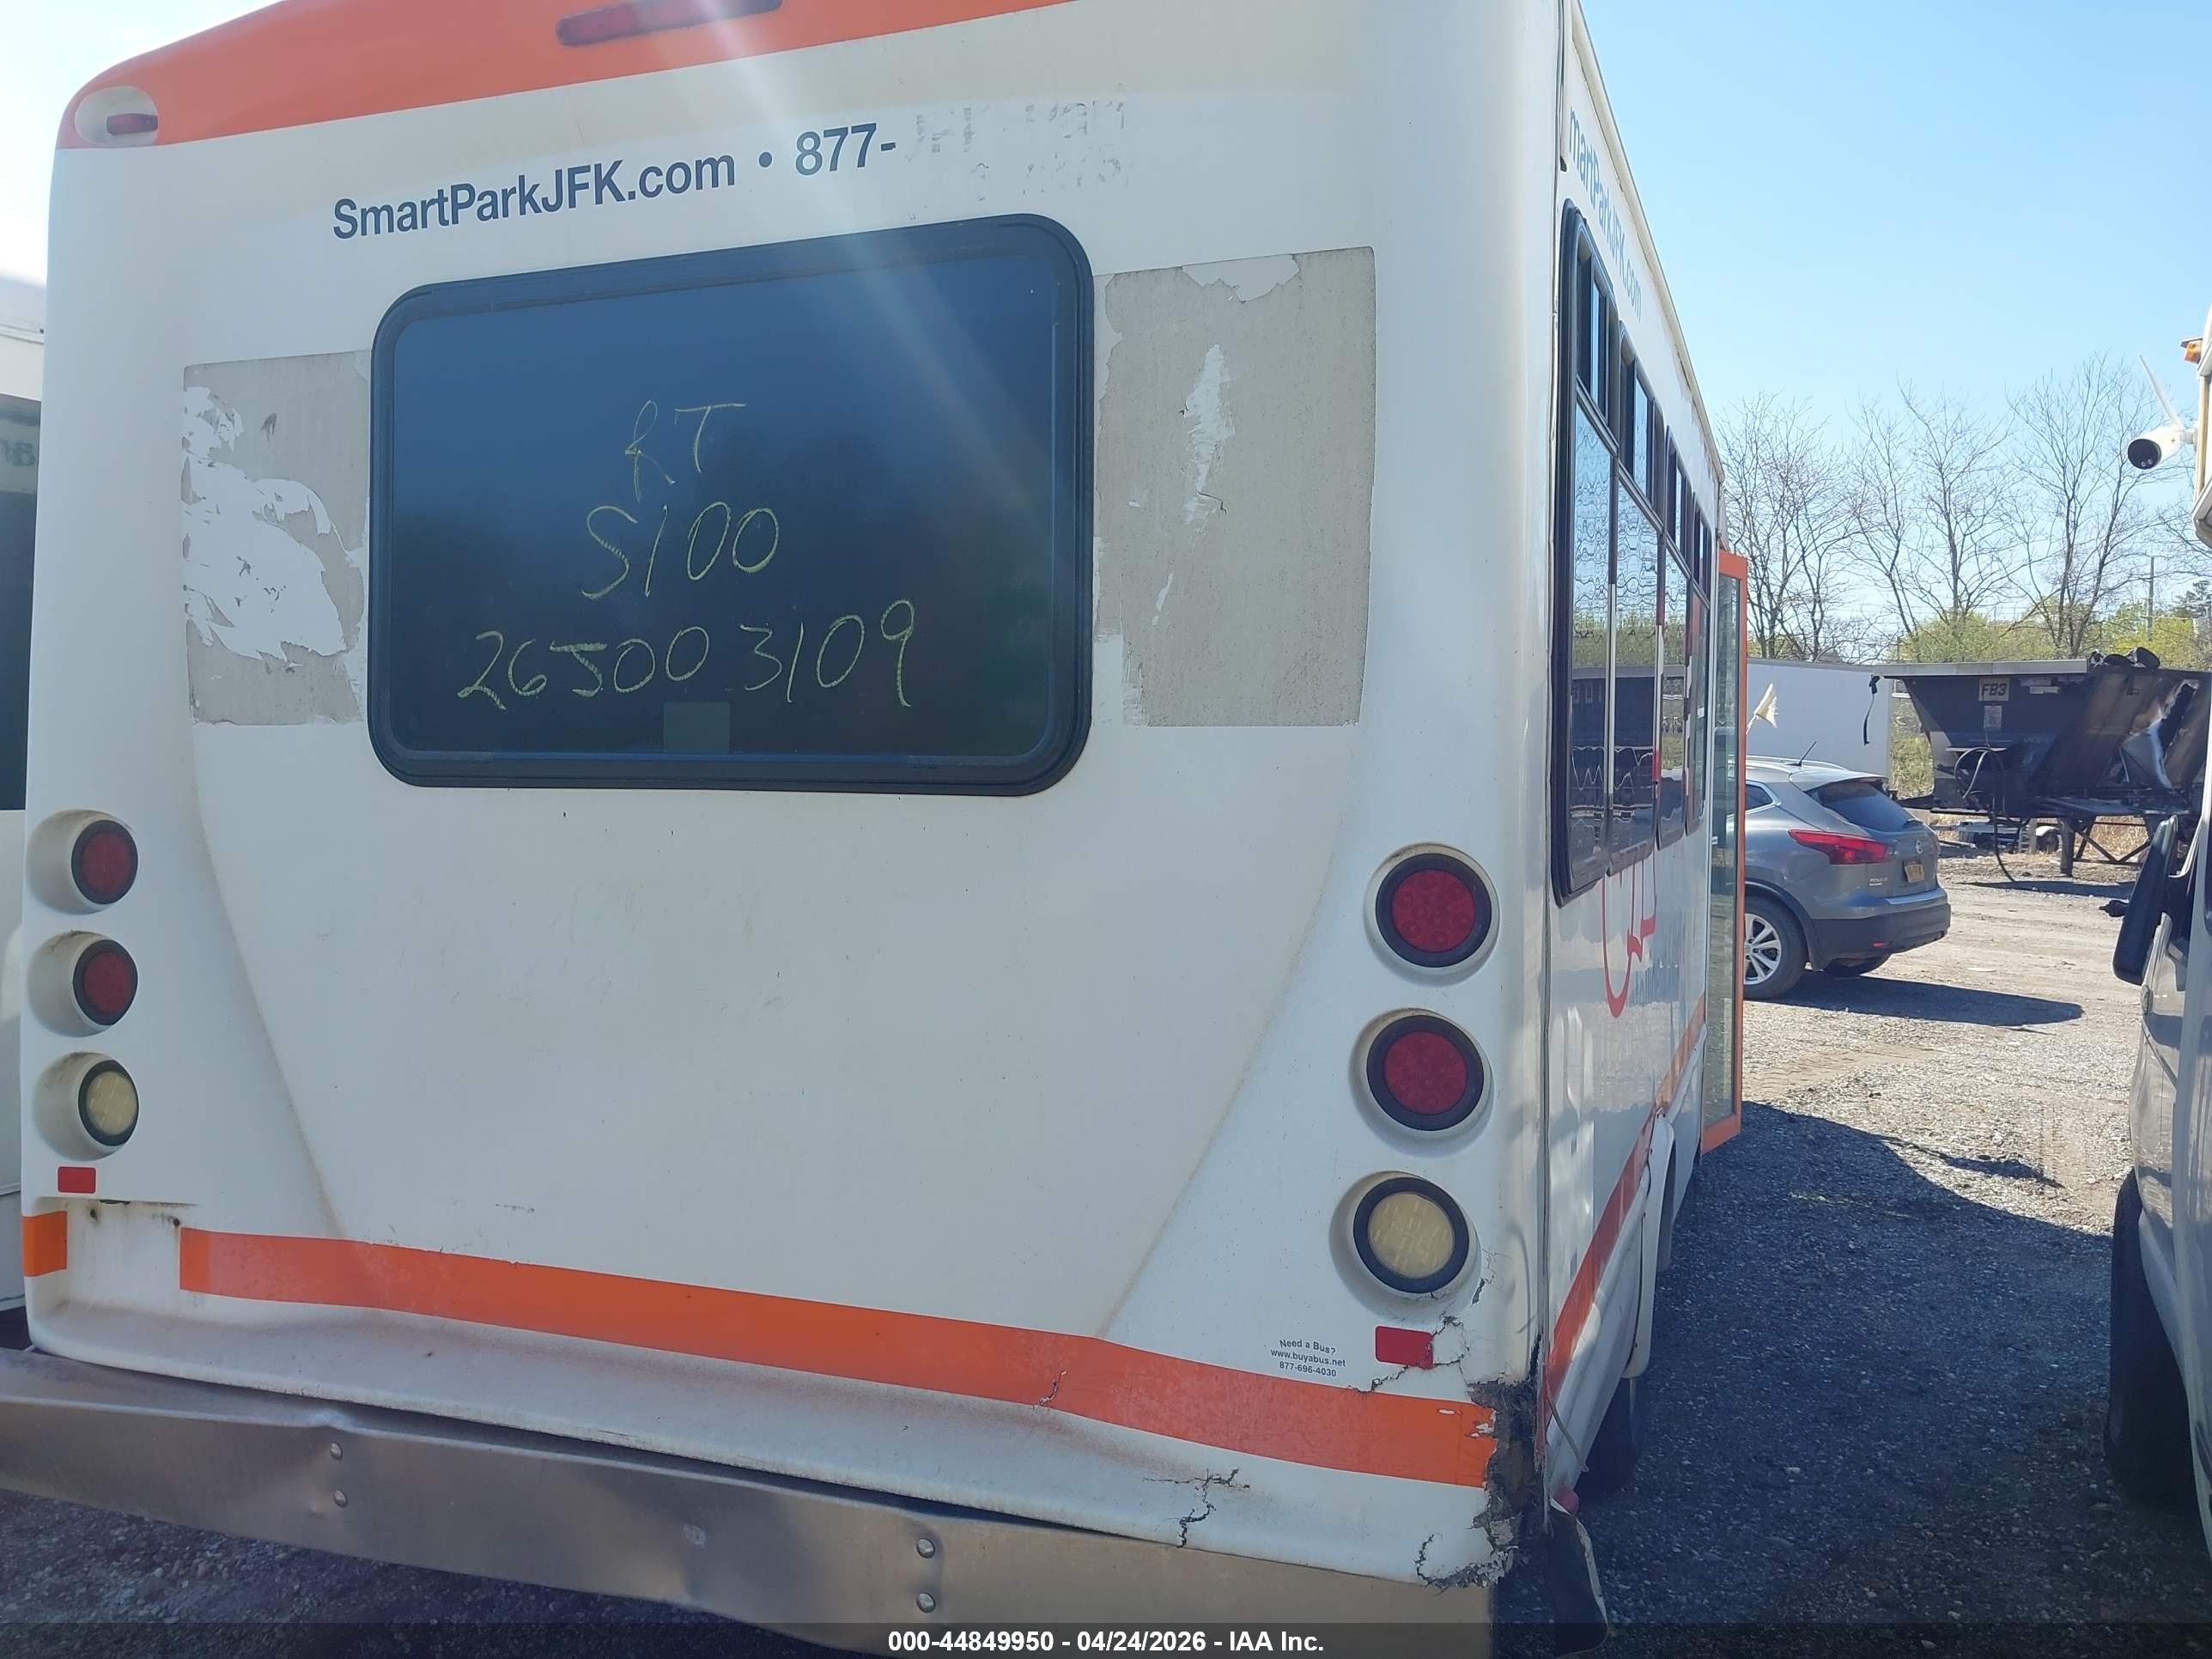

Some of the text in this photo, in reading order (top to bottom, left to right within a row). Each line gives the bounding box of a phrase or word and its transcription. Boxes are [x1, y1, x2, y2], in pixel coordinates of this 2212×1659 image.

[332, 154, 736, 240] SmartParkJFK.com
[795, 122, 896, 177] 877-
[1279, 1339, 1336, 1356] Need a Bus?
[1270, 1348, 1346, 1368] www.buyabus.net
[1279, 1360, 1337, 1377] 877-696-4030
